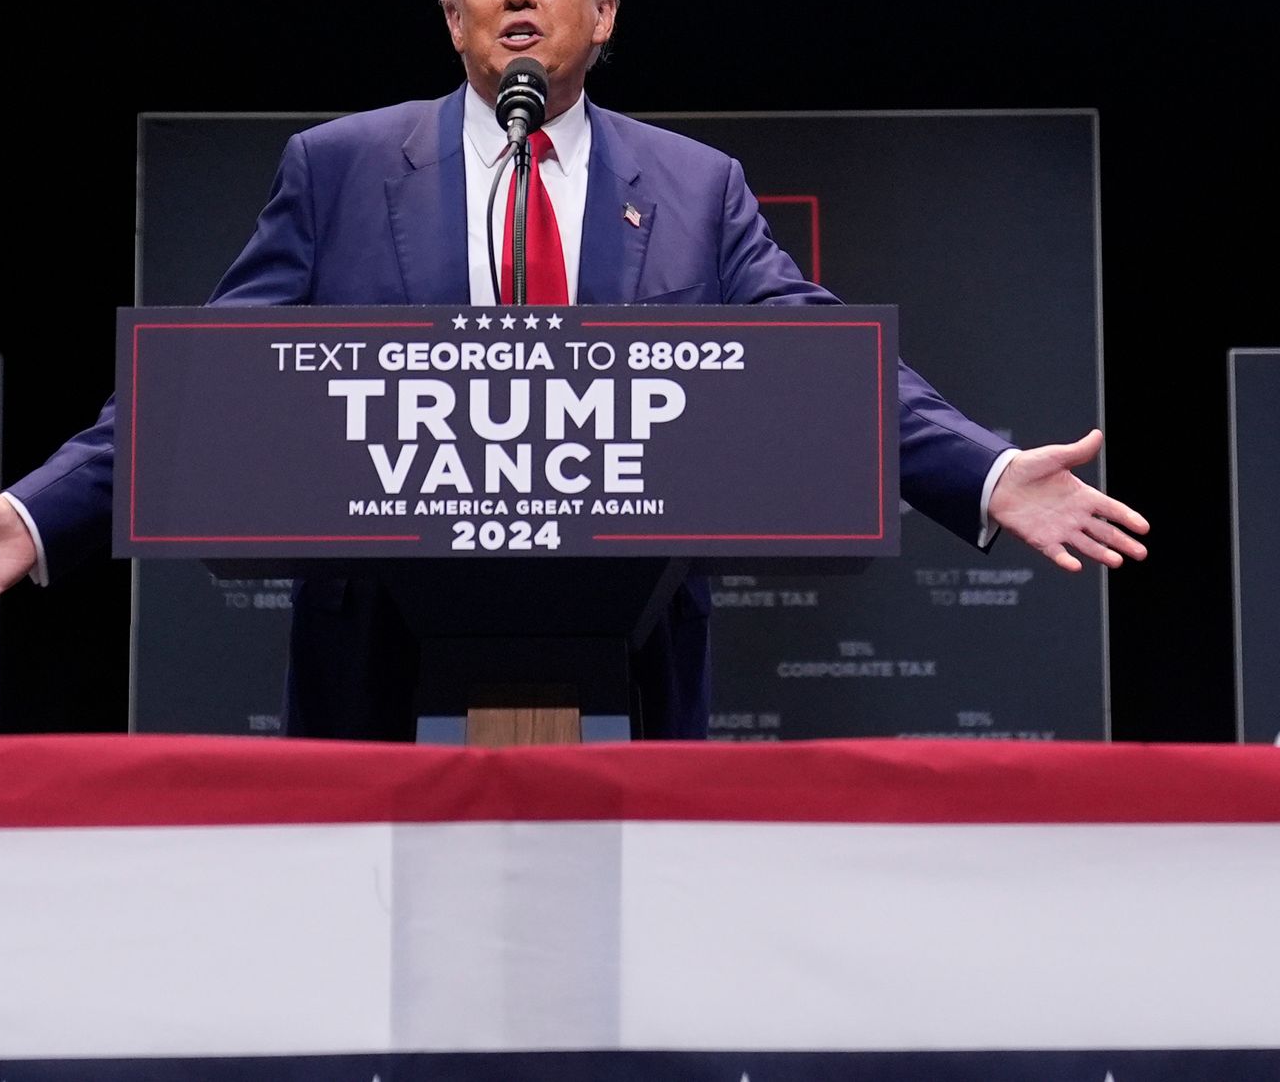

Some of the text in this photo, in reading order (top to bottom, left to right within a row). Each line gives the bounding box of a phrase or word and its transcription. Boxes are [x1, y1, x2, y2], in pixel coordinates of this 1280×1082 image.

[271, 341, 745, 371] TEXT GEORGIA TO 88022
[328, 378, 687, 441] TRUMP
[367, 443, 644, 494] VANCE
[349, 499, 664, 516] MAKE AMERICA GREAT AGAIN!
[451, 520, 562, 551] 2024
[965, 569, 1034, 586] TRUMP
[223, 592, 250, 609] TO
[781, 591, 818, 607] TAX
[958, 589, 1018, 606] 88022
[777, 661, 936, 678] CORPORATE TAX
